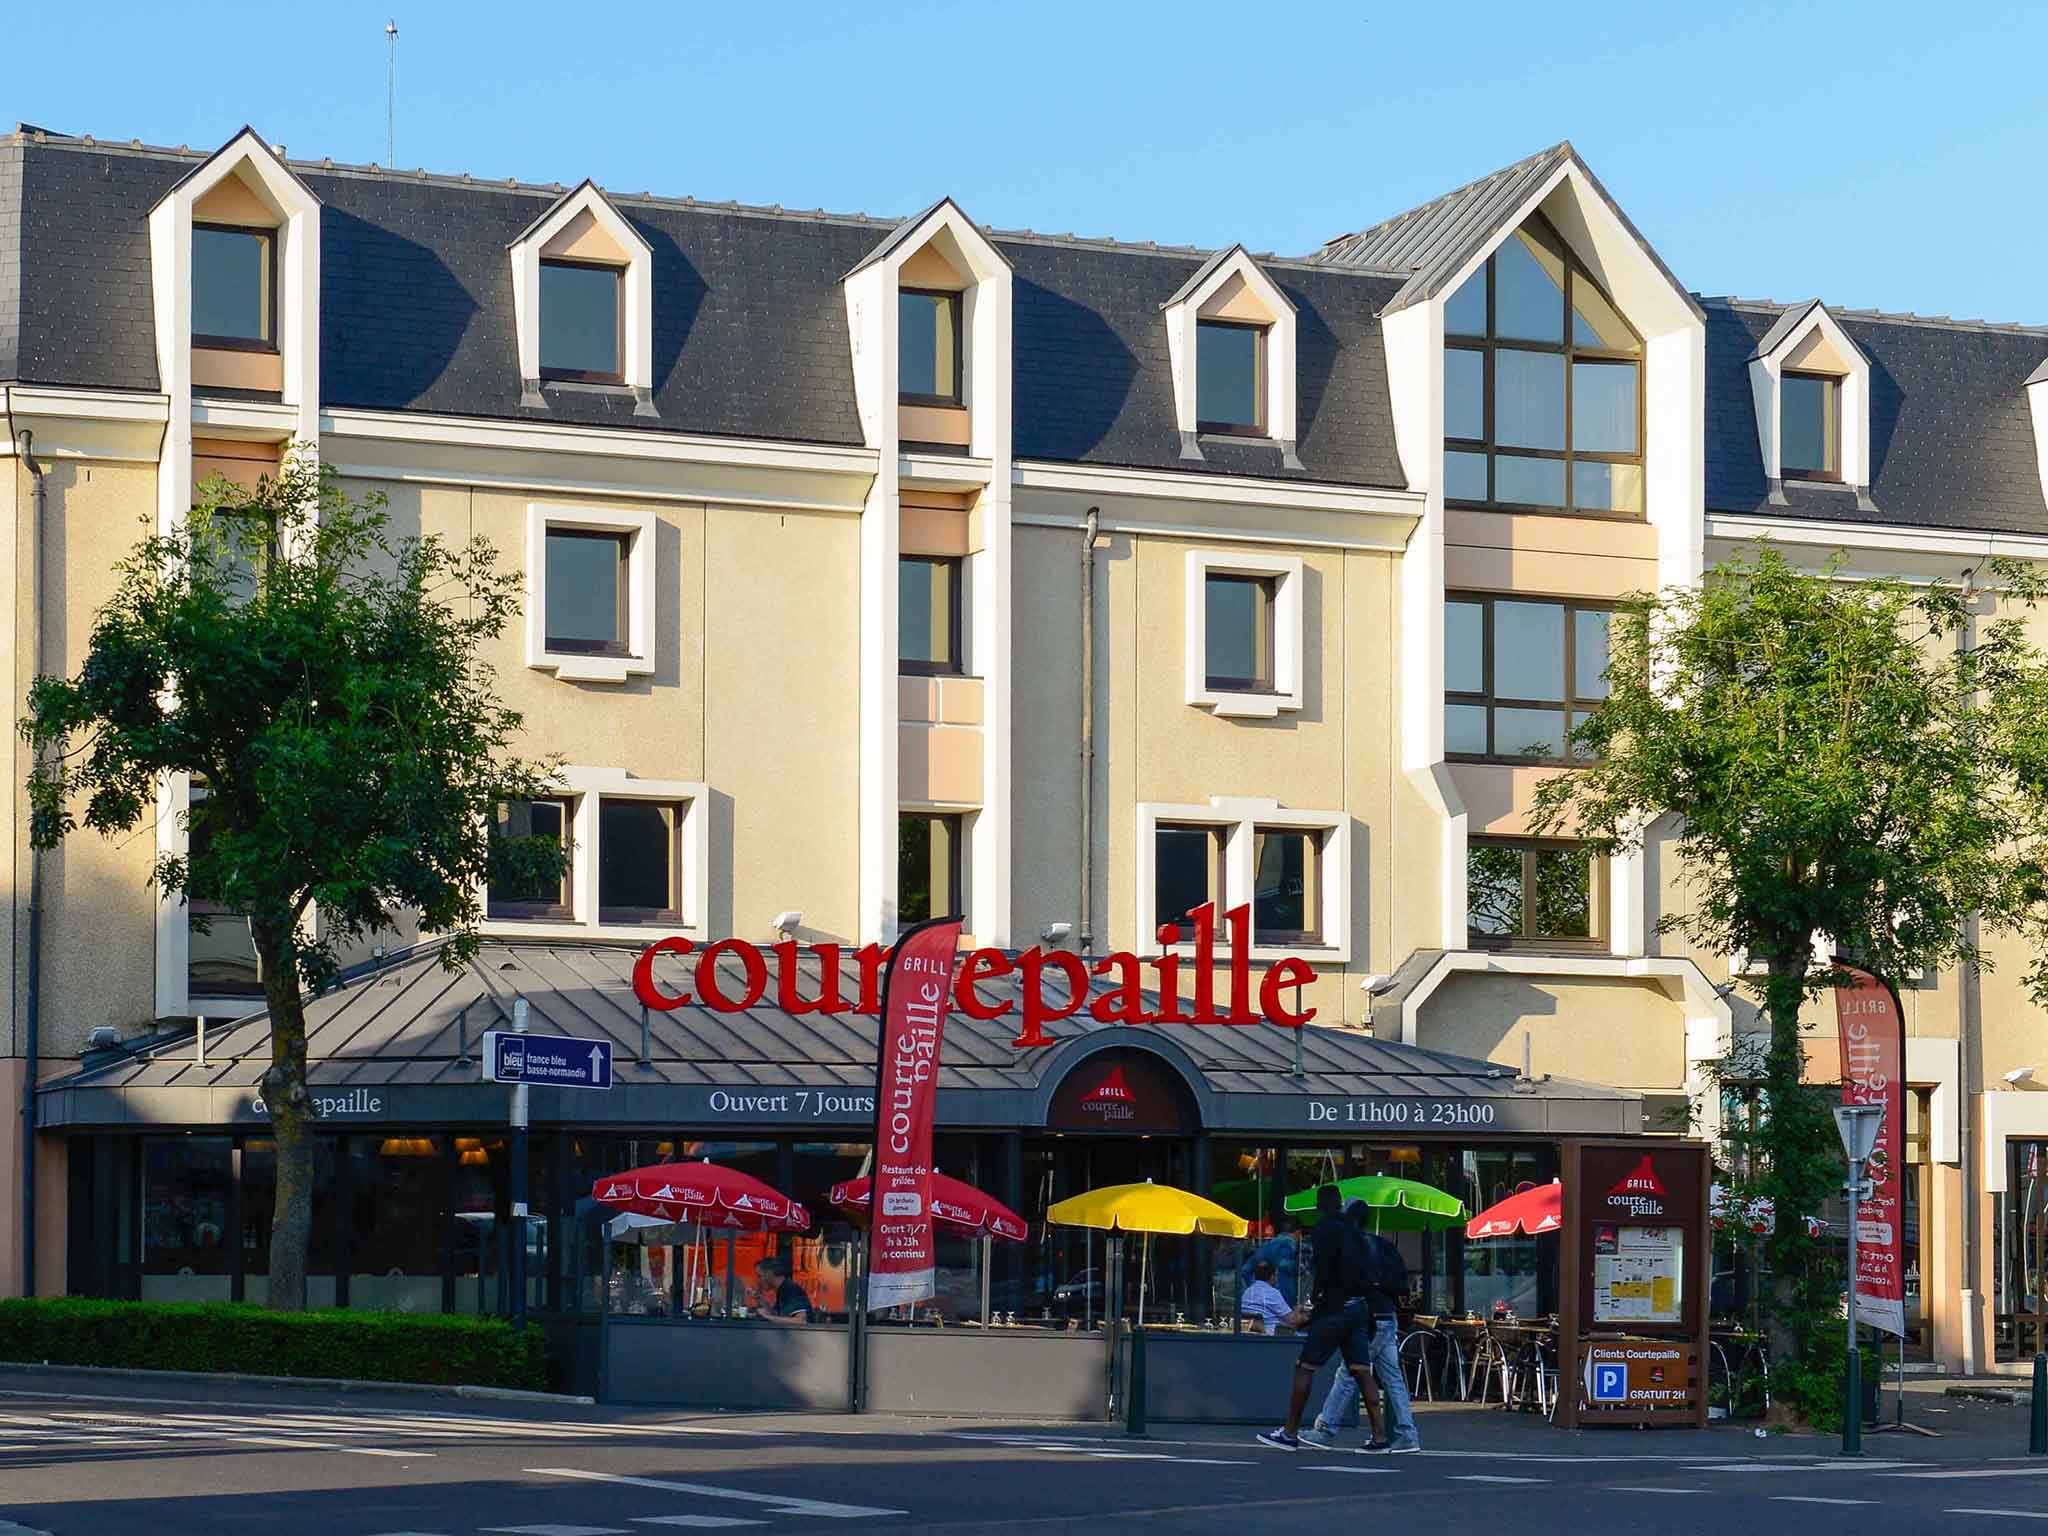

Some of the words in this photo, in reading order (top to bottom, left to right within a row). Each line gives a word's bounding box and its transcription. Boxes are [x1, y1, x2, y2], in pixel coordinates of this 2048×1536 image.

[903, 956, 947, 976] GRILL
[632, 901, 1318, 1047] courepaille
[905, 981, 940, 1083] paille
[503, 1052, 522, 1067] bleu
[527, 1053, 549, 1065] france
[551, 1055, 567, 1066] bleu
[527, 1065, 586, 1079] basse-normandie
[890, 1033, 916, 1153] courte
[1099, 1087, 1125, 1097] GRILL
[252, 1088, 382, 1118] cepaille
[709, 1091, 788, 1112] Ouvert
[795, 1092, 808, 1113] 7
[813, 1092, 874, 1116] Jours
[1082, 1102, 1120, 1111] courte
[1104, 1106, 1134, 1120] paille
[1308, 1102, 1337, 1121] De
[1346, 1102, 1408, 1122] 11h00
[1414, 1103, 1425, 1122] à
[1431, 1104, 1495, 1125] 23h00
[914, 1165, 927, 1176] de
[1627, 1179, 1655, 1190] GRILL
[1607, 1195, 1648, 1206] courte
[1631, 1200, 1664, 1217] paille
[890, 1248, 925, 1259] continu
[1593, 1349, 1625, 1359] Clients
[1626, 1349, 1681, 1361] Courtepaille
[1603, 1371, 1617, 1393] P
[1630, 1390, 1670, 1400] GRATUIT
[1672, 1390, 1686, 1400] 2H
